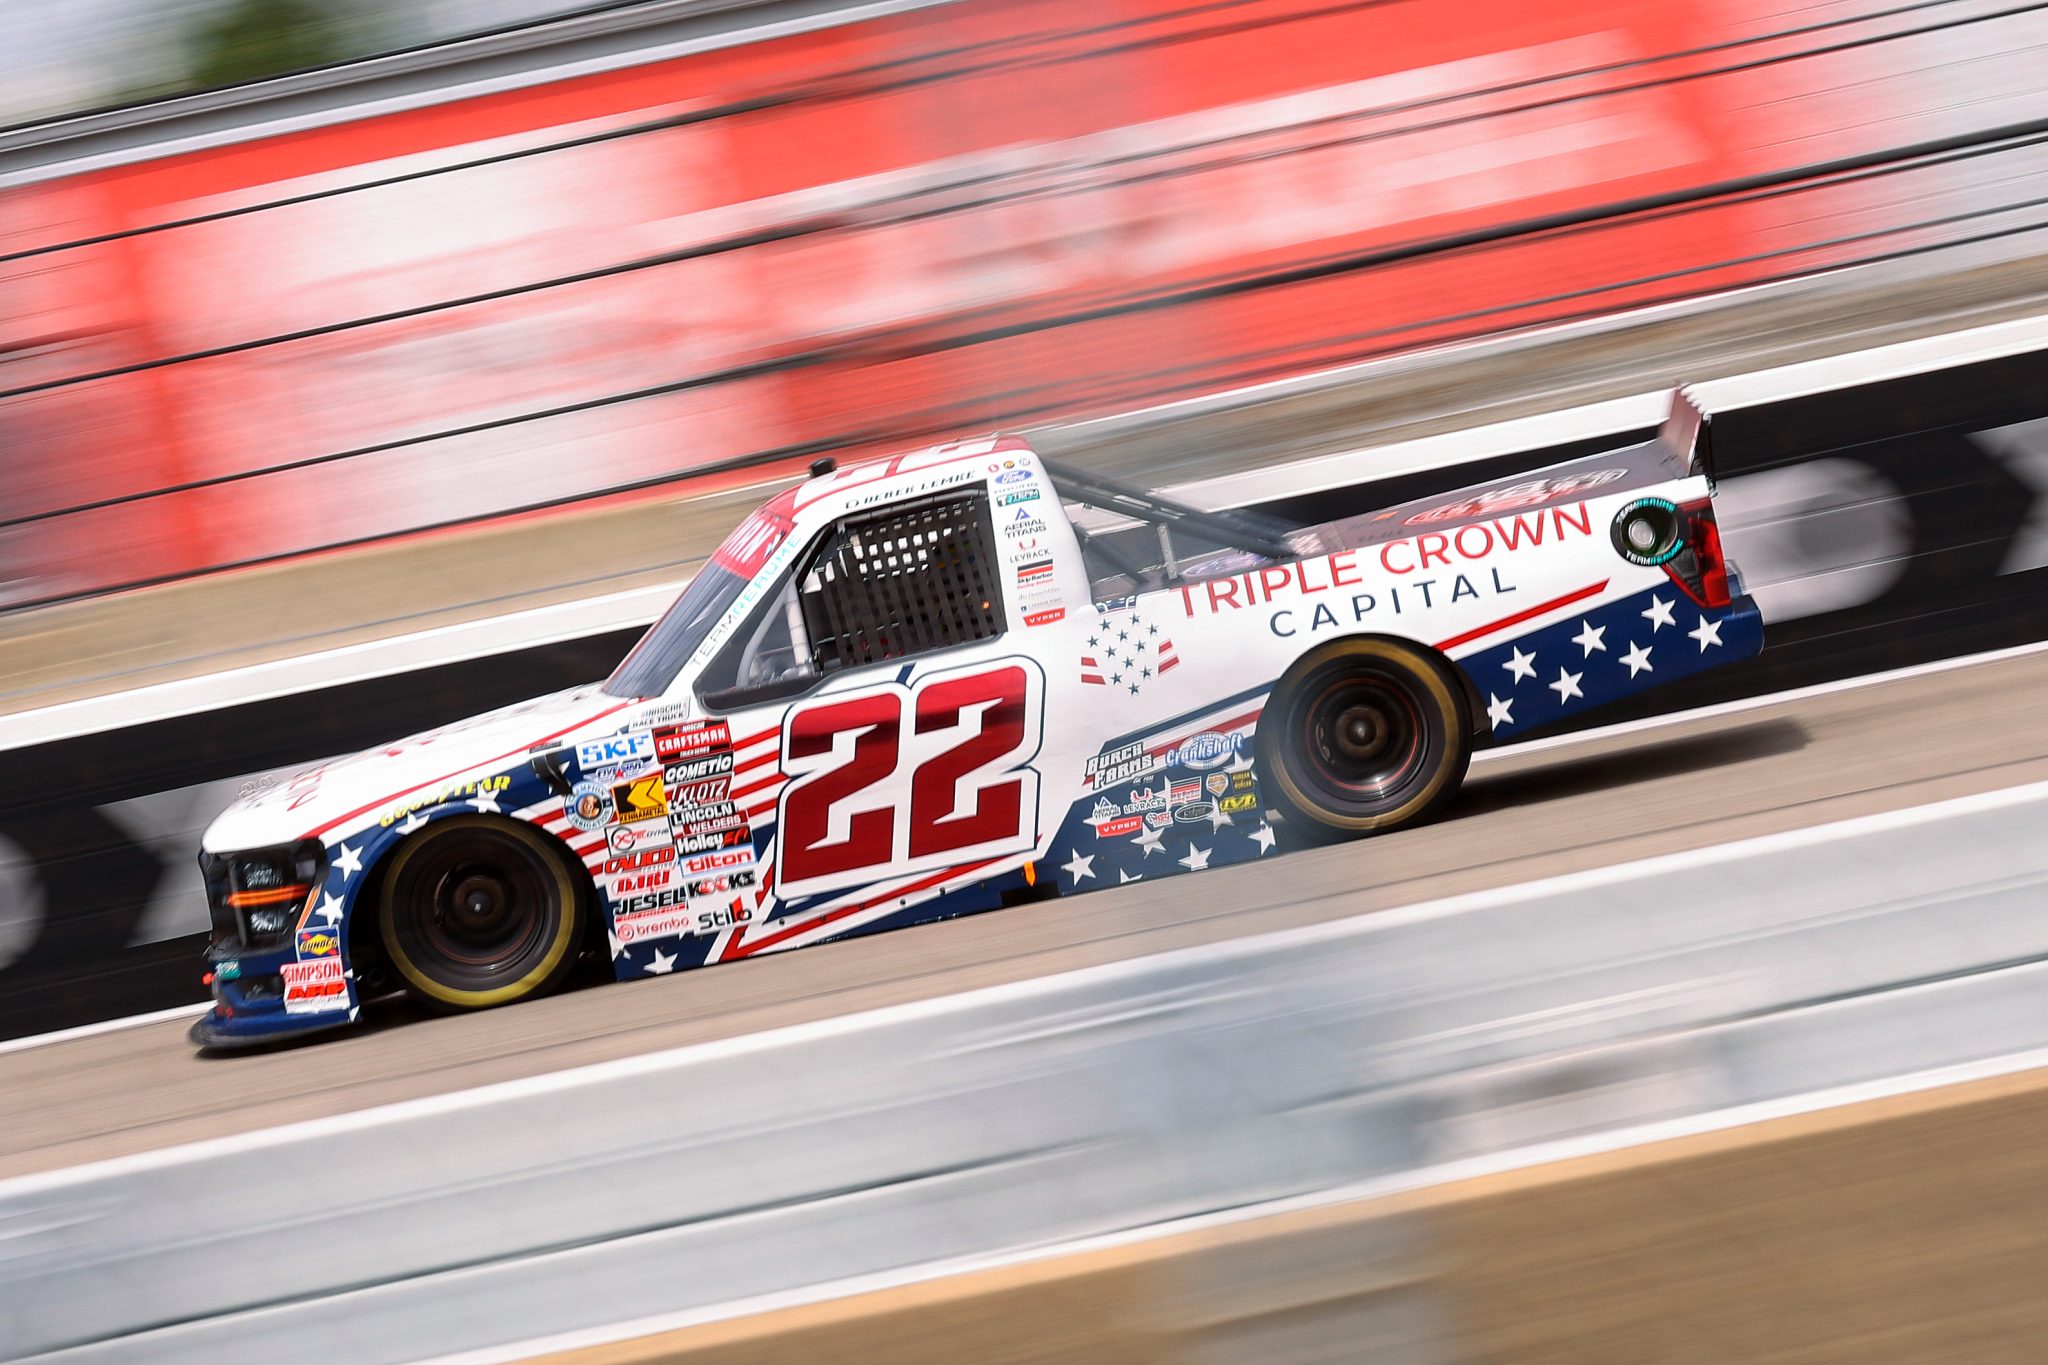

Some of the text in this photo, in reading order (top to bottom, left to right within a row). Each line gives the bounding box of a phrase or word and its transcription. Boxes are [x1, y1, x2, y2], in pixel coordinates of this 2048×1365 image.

[920, 470, 977, 491] LEMKE
[1005, 517, 1045, 533] AERIAL
[1005, 524, 1047, 540] TITANS
[1009, 548, 1052, 564] LEVRACK
[1168, 501, 1593, 619] TRIPLE CROWN
[1269, 565, 1518, 639] CAPITAL
[1028, 611, 1061, 624] VYPER
[581, 733, 650, 765] SKF
[658, 728, 727, 753] CRAFTSMAN
[1165, 732, 1244, 767] Crankshaft
[665, 754, 732, 782] COMETIC
[1085, 742, 1144, 778] BURCH
[1093, 752, 1154, 791] FARMS
[776, 660, 1032, 889] 22
[379, 775, 511, 828] GOODYEAR
[677, 780, 728, 803] KLOTZ
[673, 802, 734, 826] LINCOLN
[1123, 797, 1165, 814] LEVRACK
[689, 815, 742, 834] WELDERS
[1103, 820, 1137, 833] VYPER
[676, 832, 725, 855] Holley
[604, 846, 675, 874] CALICO
[686, 849, 752, 874] tilton
[614, 886, 687, 916] JESEL
[636, 916, 690, 937] brembo
[698, 898, 753, 931] Stilo
[300, 937, 338, 956] SUNOCO
[283, 961, 342, 984] SIMPSON
